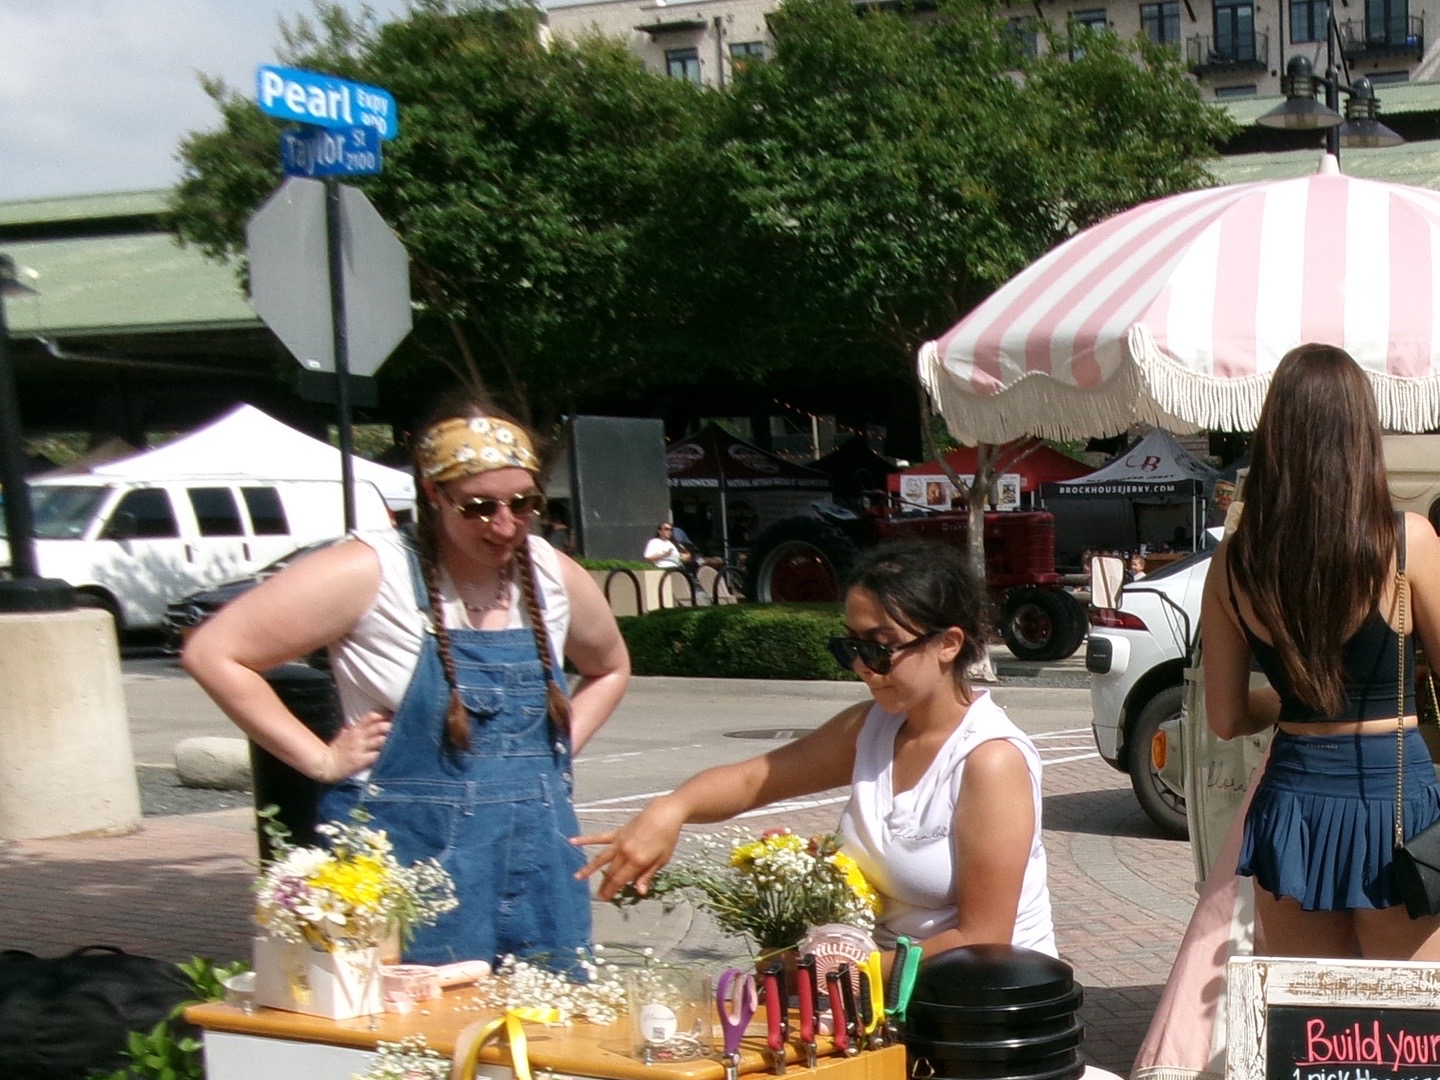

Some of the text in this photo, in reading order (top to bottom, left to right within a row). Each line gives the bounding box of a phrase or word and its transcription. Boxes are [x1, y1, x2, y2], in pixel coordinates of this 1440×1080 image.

[260, 69, 354, 125] Pearl
[284, 132, 346, 176] Taylor
[1059, 485, 1175, 495] BROCKHOUSEJERKY.COM
[1306, 1017, 1383, 1064] Build
